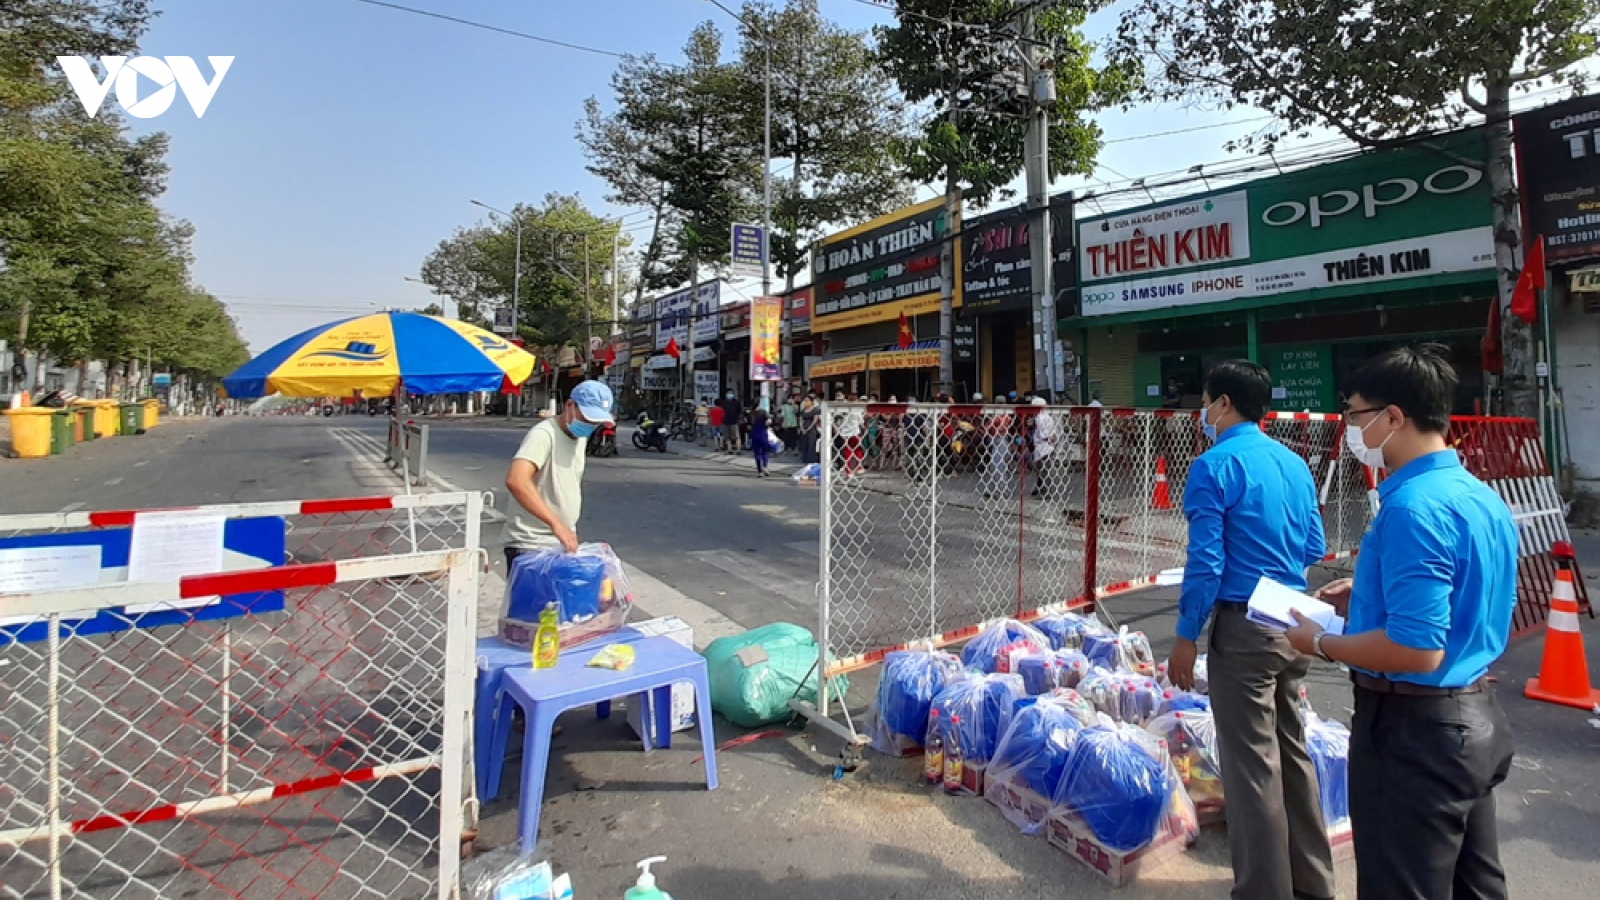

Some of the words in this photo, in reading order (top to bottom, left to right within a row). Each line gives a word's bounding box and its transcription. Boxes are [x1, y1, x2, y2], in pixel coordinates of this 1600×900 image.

[1174, 222, 1233, 265] KIM
[1323, 252, 1384, 282] THIÊN
[1390, 248, 1431, 274] KIM
[1122, 282, 1185, 301] SAMSUNG
[1191, 275, 1244, 293] IPHONE
